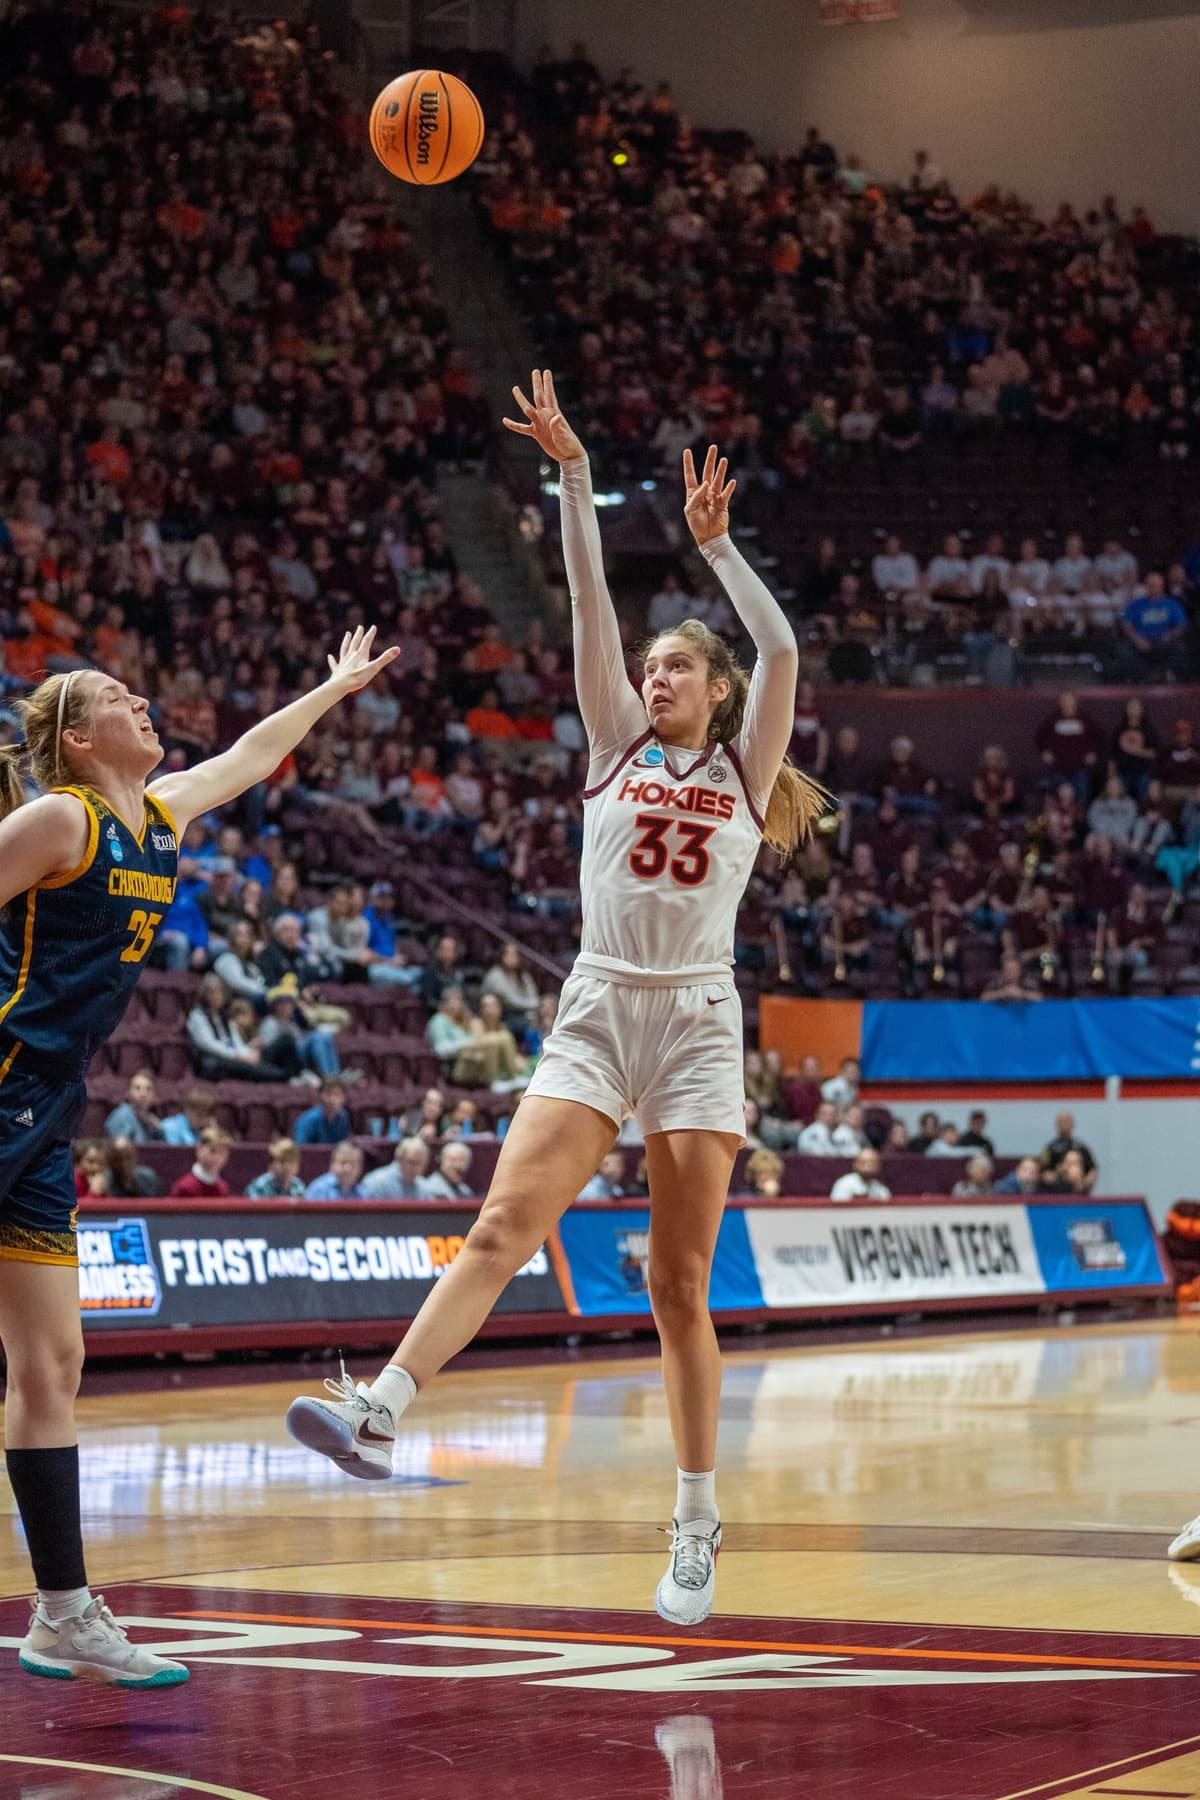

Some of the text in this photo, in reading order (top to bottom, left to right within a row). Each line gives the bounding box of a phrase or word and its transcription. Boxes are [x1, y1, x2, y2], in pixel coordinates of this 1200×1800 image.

[417, 91, 439, 164] Wilson
[617, 779, 736, 820] HOKIES
[629, 813, 717, 886] 33
[120, 909, 163, 963] 25
[159, 1237, 268, 1286] FIRST
[267, 1247, 309, 1278] AND
[304, 1235, 433, 1282] SECOND
[831, 1224, 952, 1282] VIRGINIA
[950, 1222, 1021, 1276] TECH
